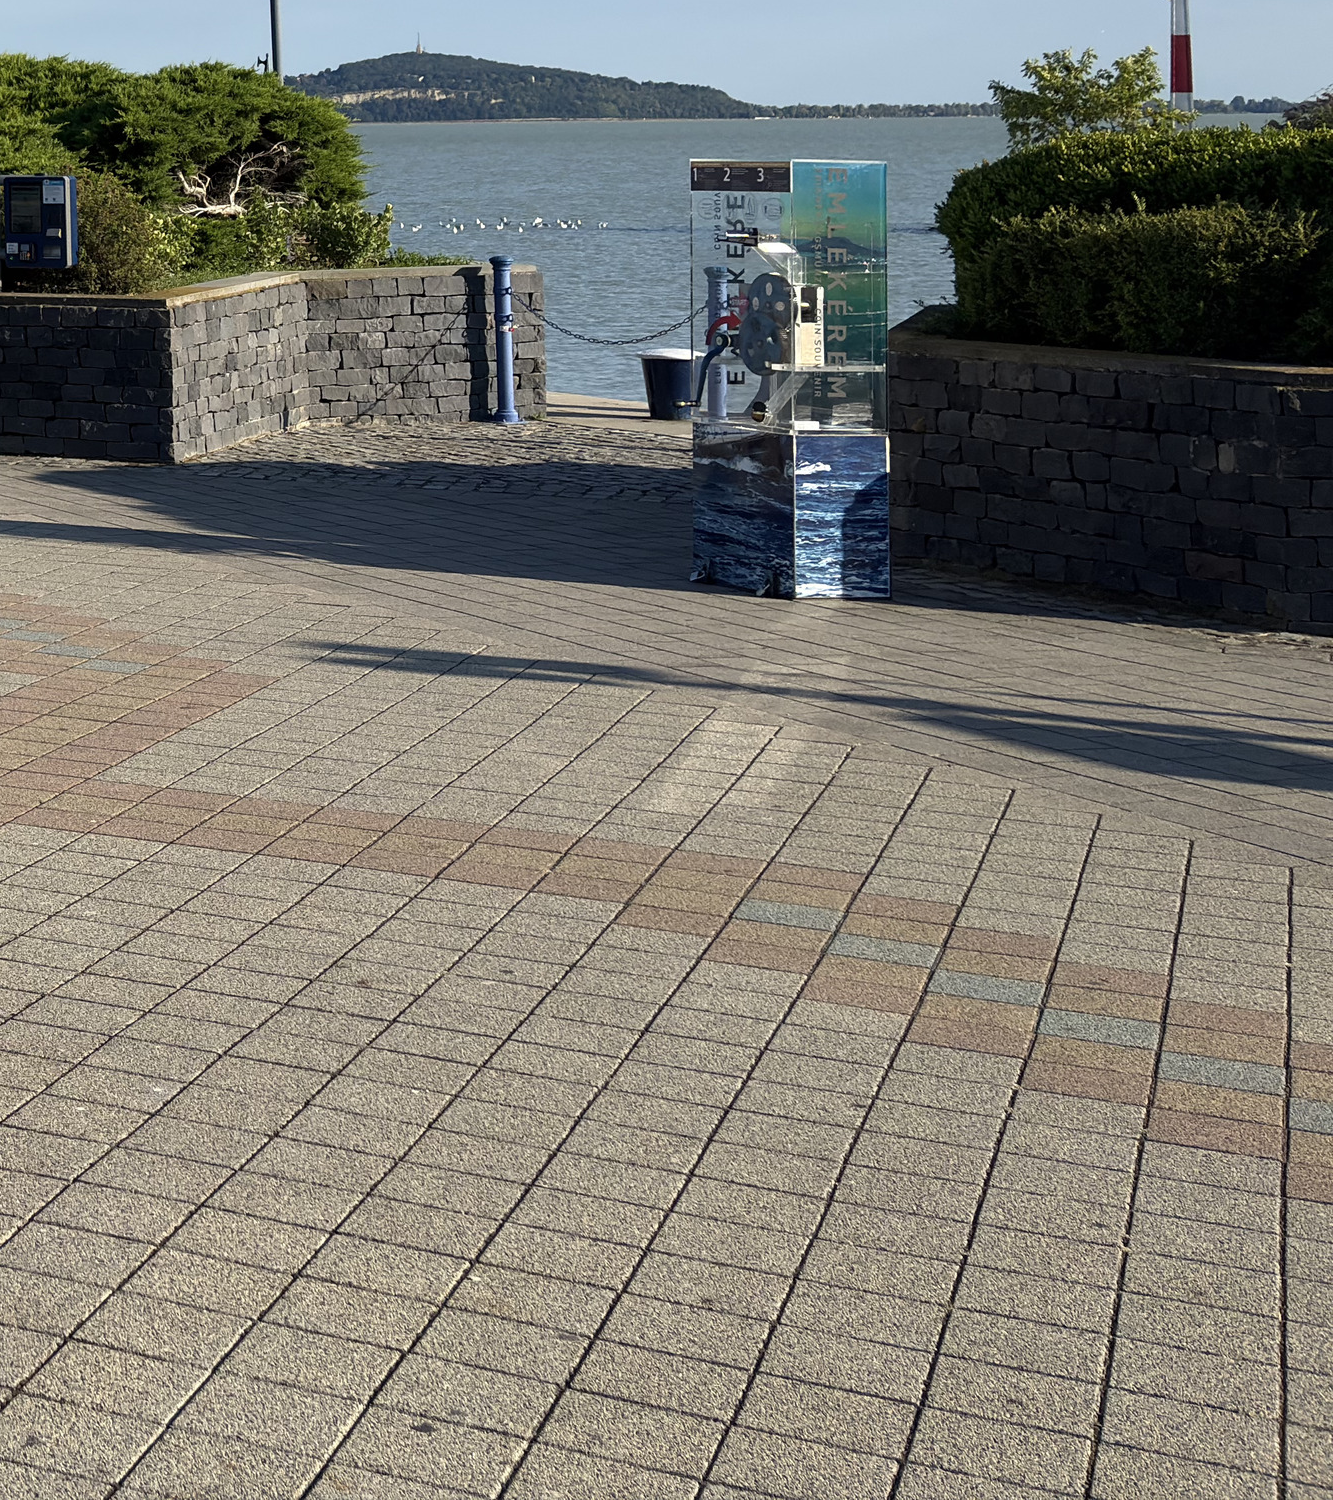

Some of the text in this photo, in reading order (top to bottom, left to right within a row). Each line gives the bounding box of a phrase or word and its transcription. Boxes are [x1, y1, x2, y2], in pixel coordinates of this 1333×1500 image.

[692, 167, 698, 182] 1
[723, 167, 731, 182] 2
[756, 167, 765, 182] 3
